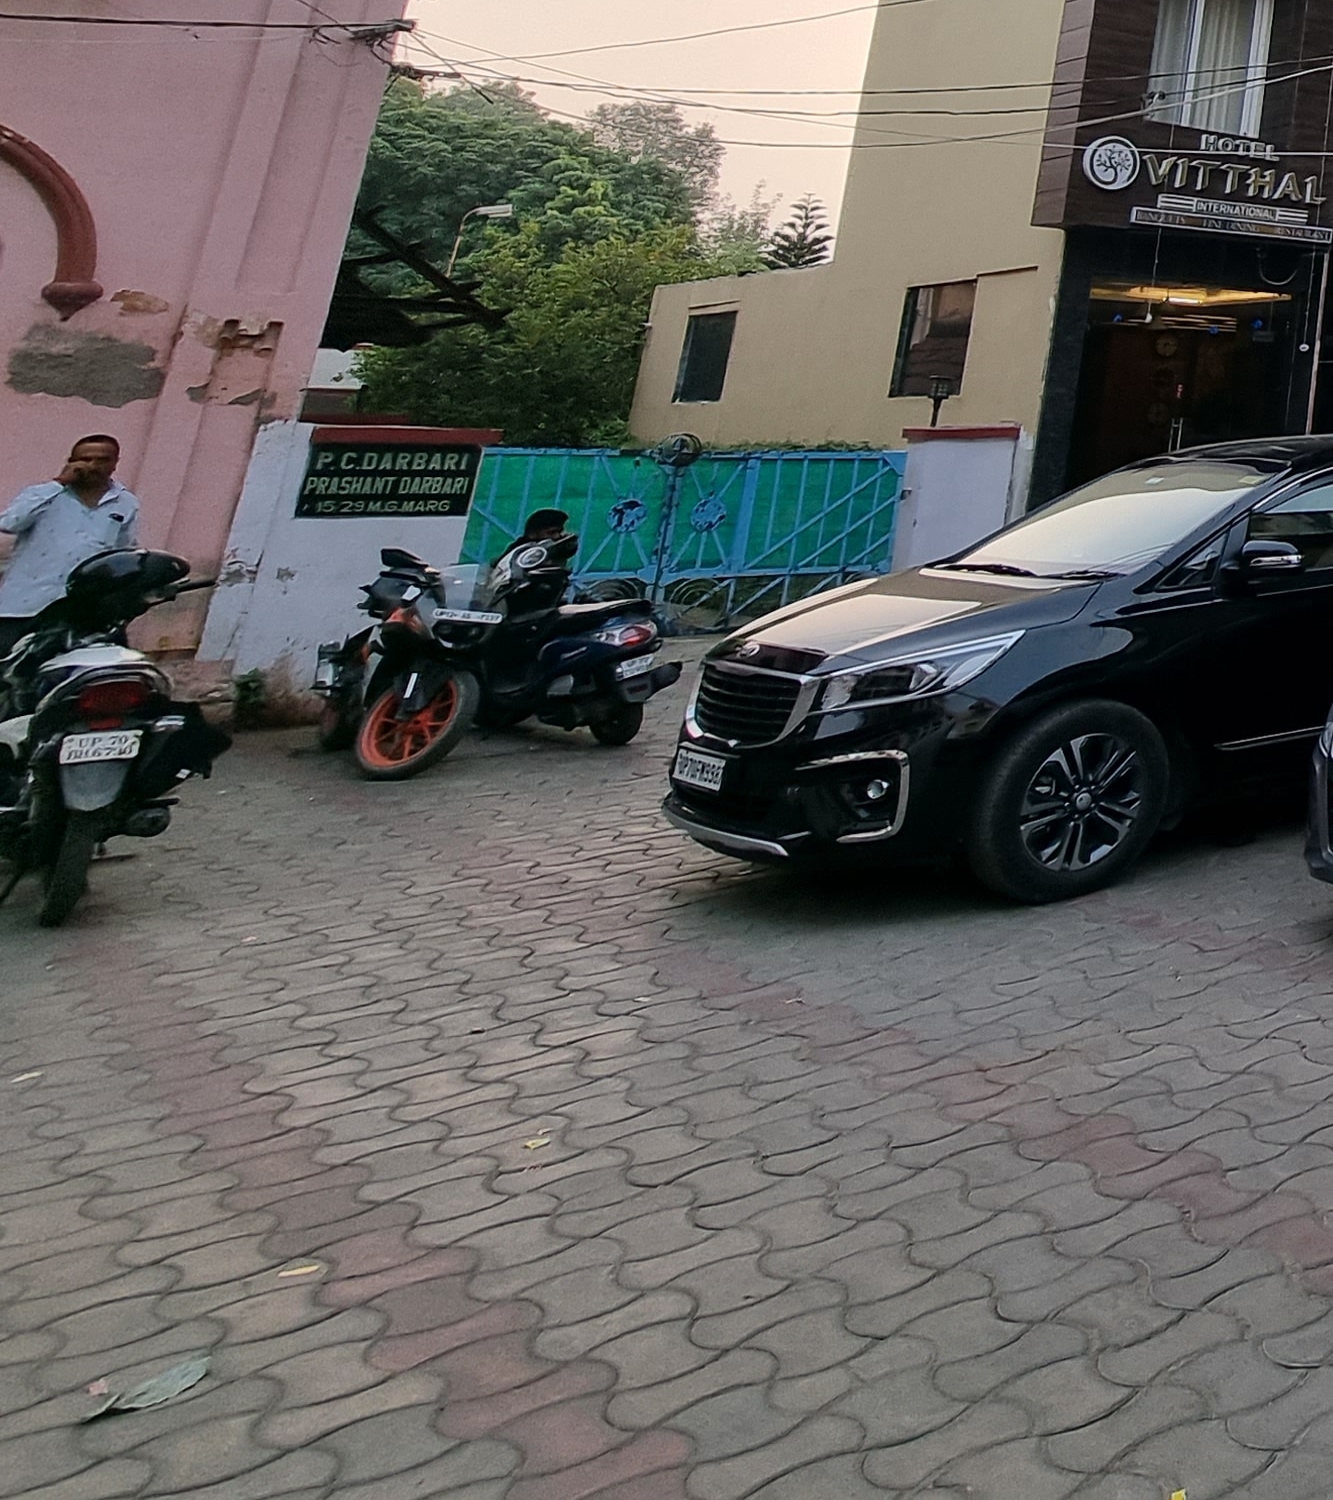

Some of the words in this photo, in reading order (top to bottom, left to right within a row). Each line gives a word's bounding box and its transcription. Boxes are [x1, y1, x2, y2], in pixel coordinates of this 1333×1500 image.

[1199, 133, 1280, 162] HOTEL
[1142, 154, 1327, 205] VITTHAL
[1196, 201, 1275, 220] INTERNATIONAL
[303, 476, 398, 495] PRASHANT
[397, 476, 470, 495] DARBARI
